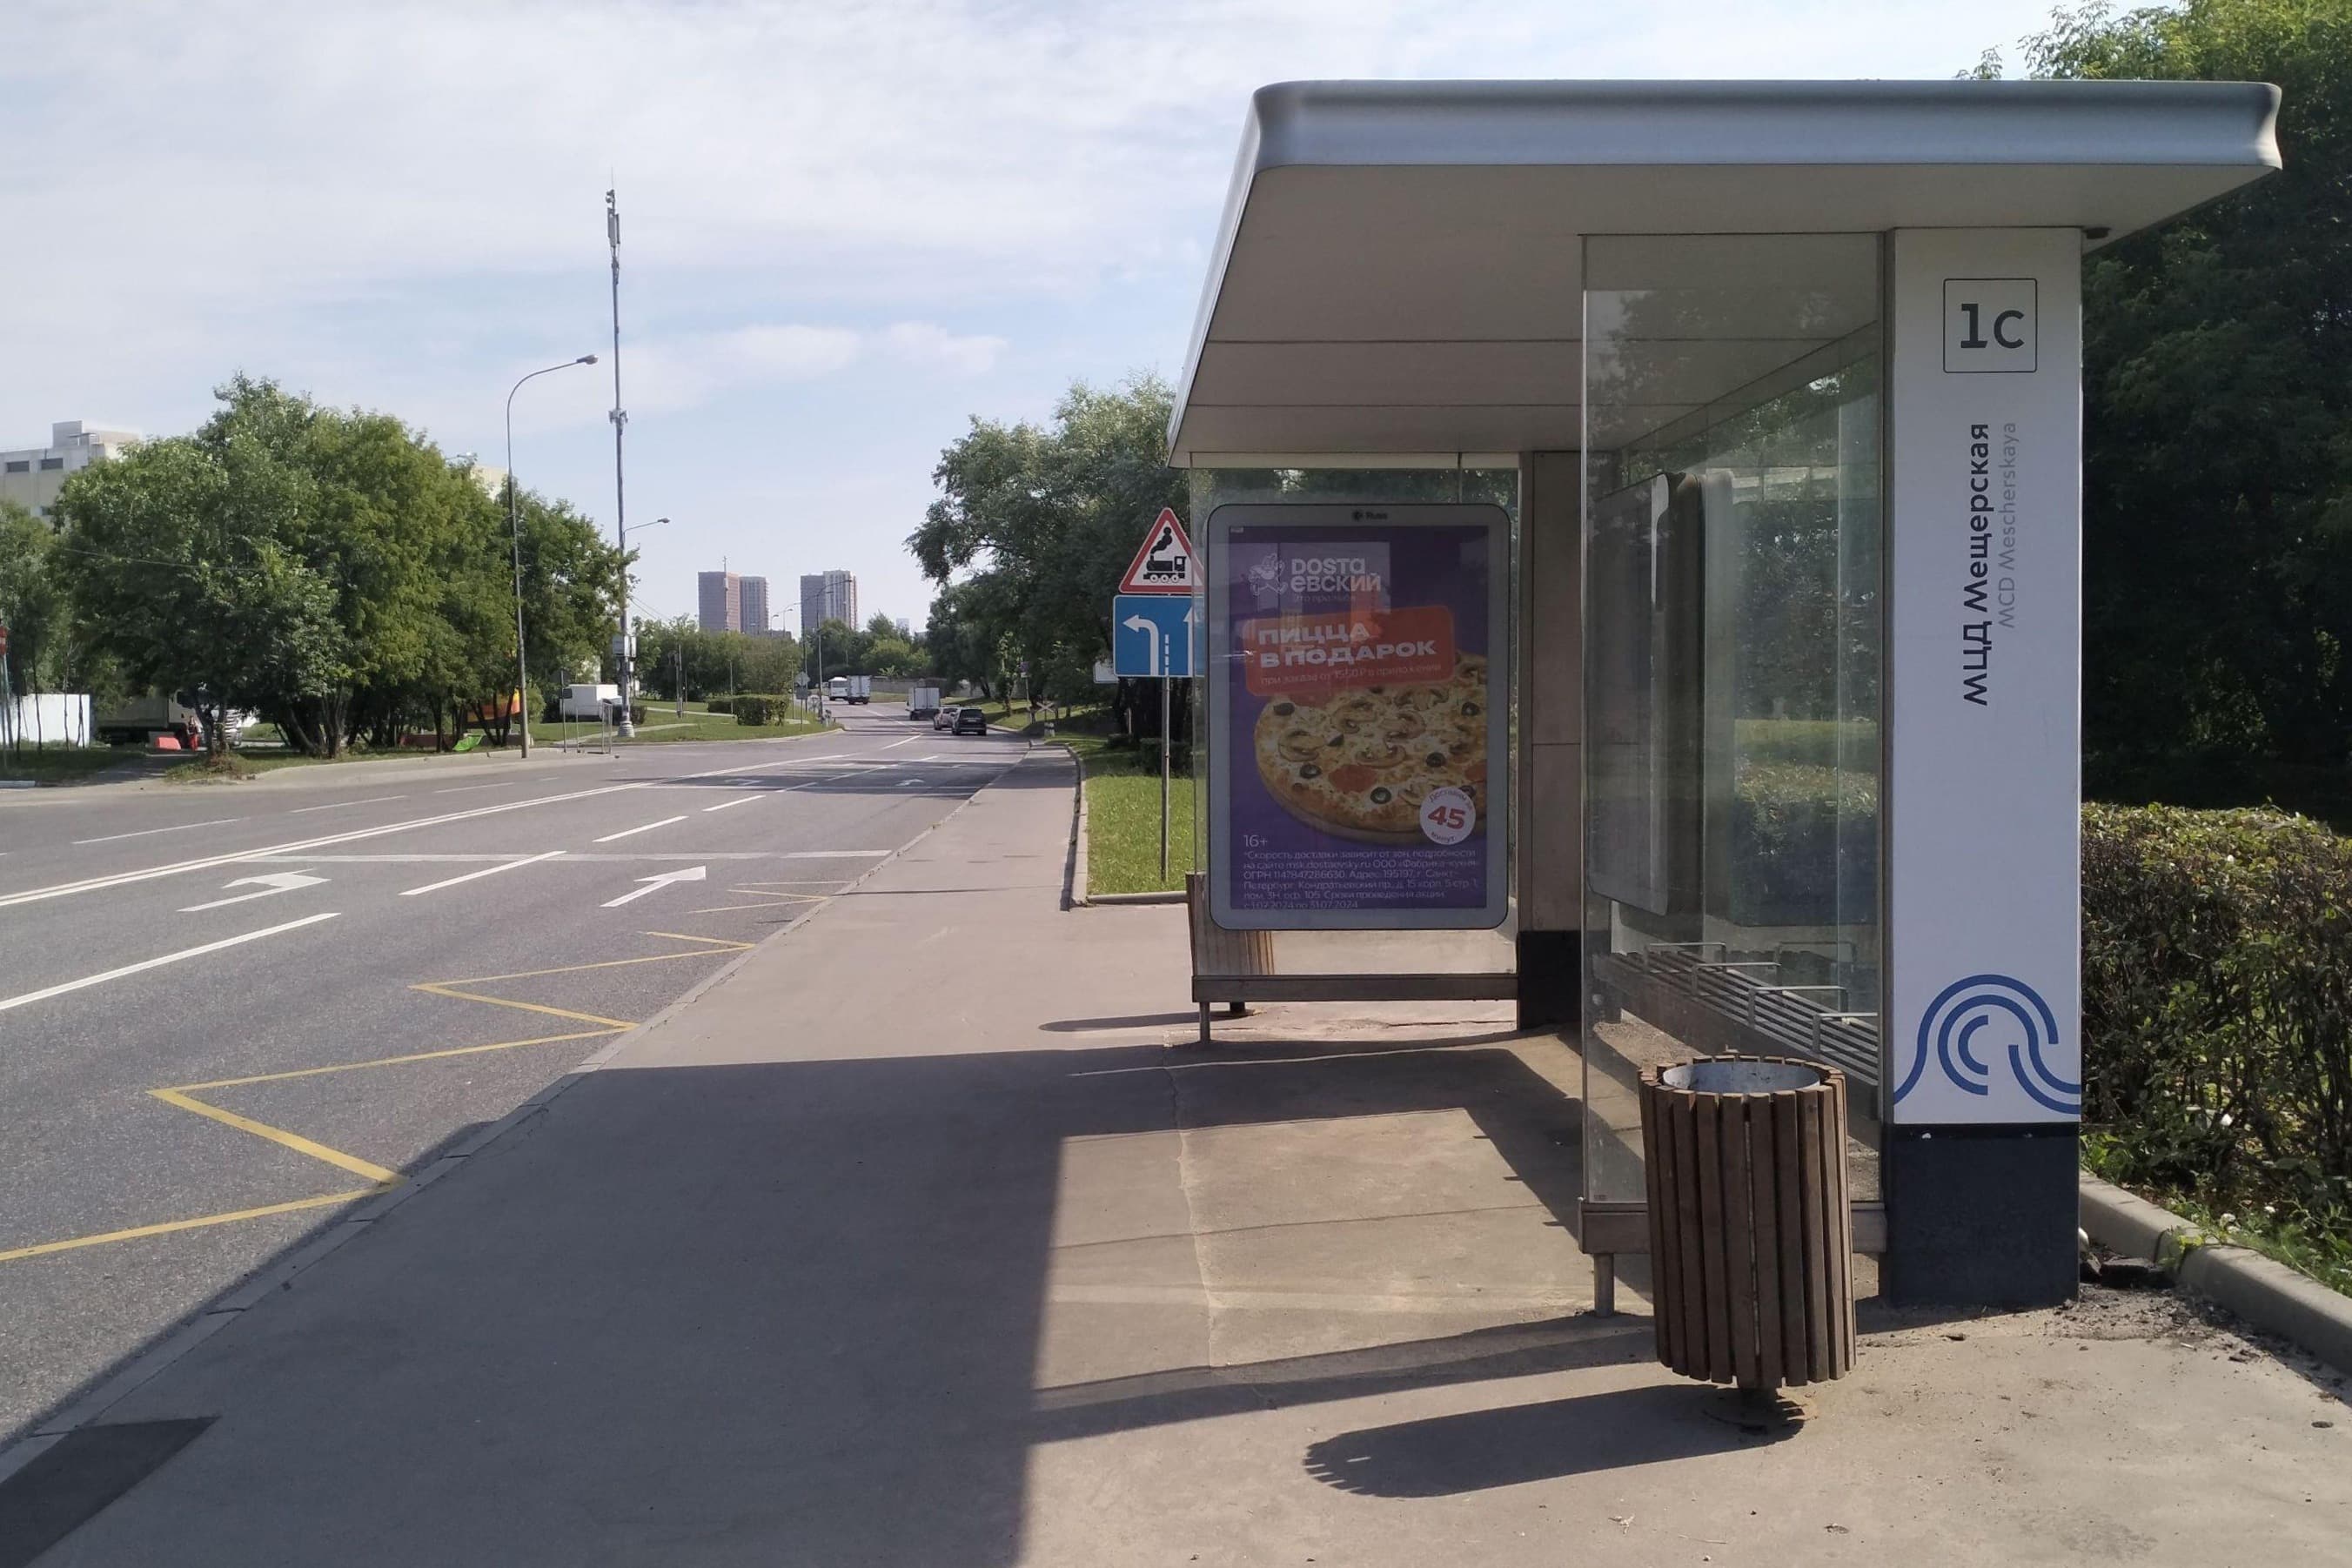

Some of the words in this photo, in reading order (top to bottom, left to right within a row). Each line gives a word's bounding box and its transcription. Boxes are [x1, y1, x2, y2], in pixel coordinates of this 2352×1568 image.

[1998, 422, 2020, 570] Mescherskaya
[1963, 424, 1994, 613] Мещерская
[1998, 576, 2016, 628] MCD
[1258, 621, 1370, 646] ПИЦЦА
[1260, 652, 1280, 668] В
[1284, 640, 1437, 667] ПОДАРОК
[1963, 620, 1993, 706] МЦД
[1428, 806, 1466, 829] 45
[1243, 834, 1269, 848] 16+
